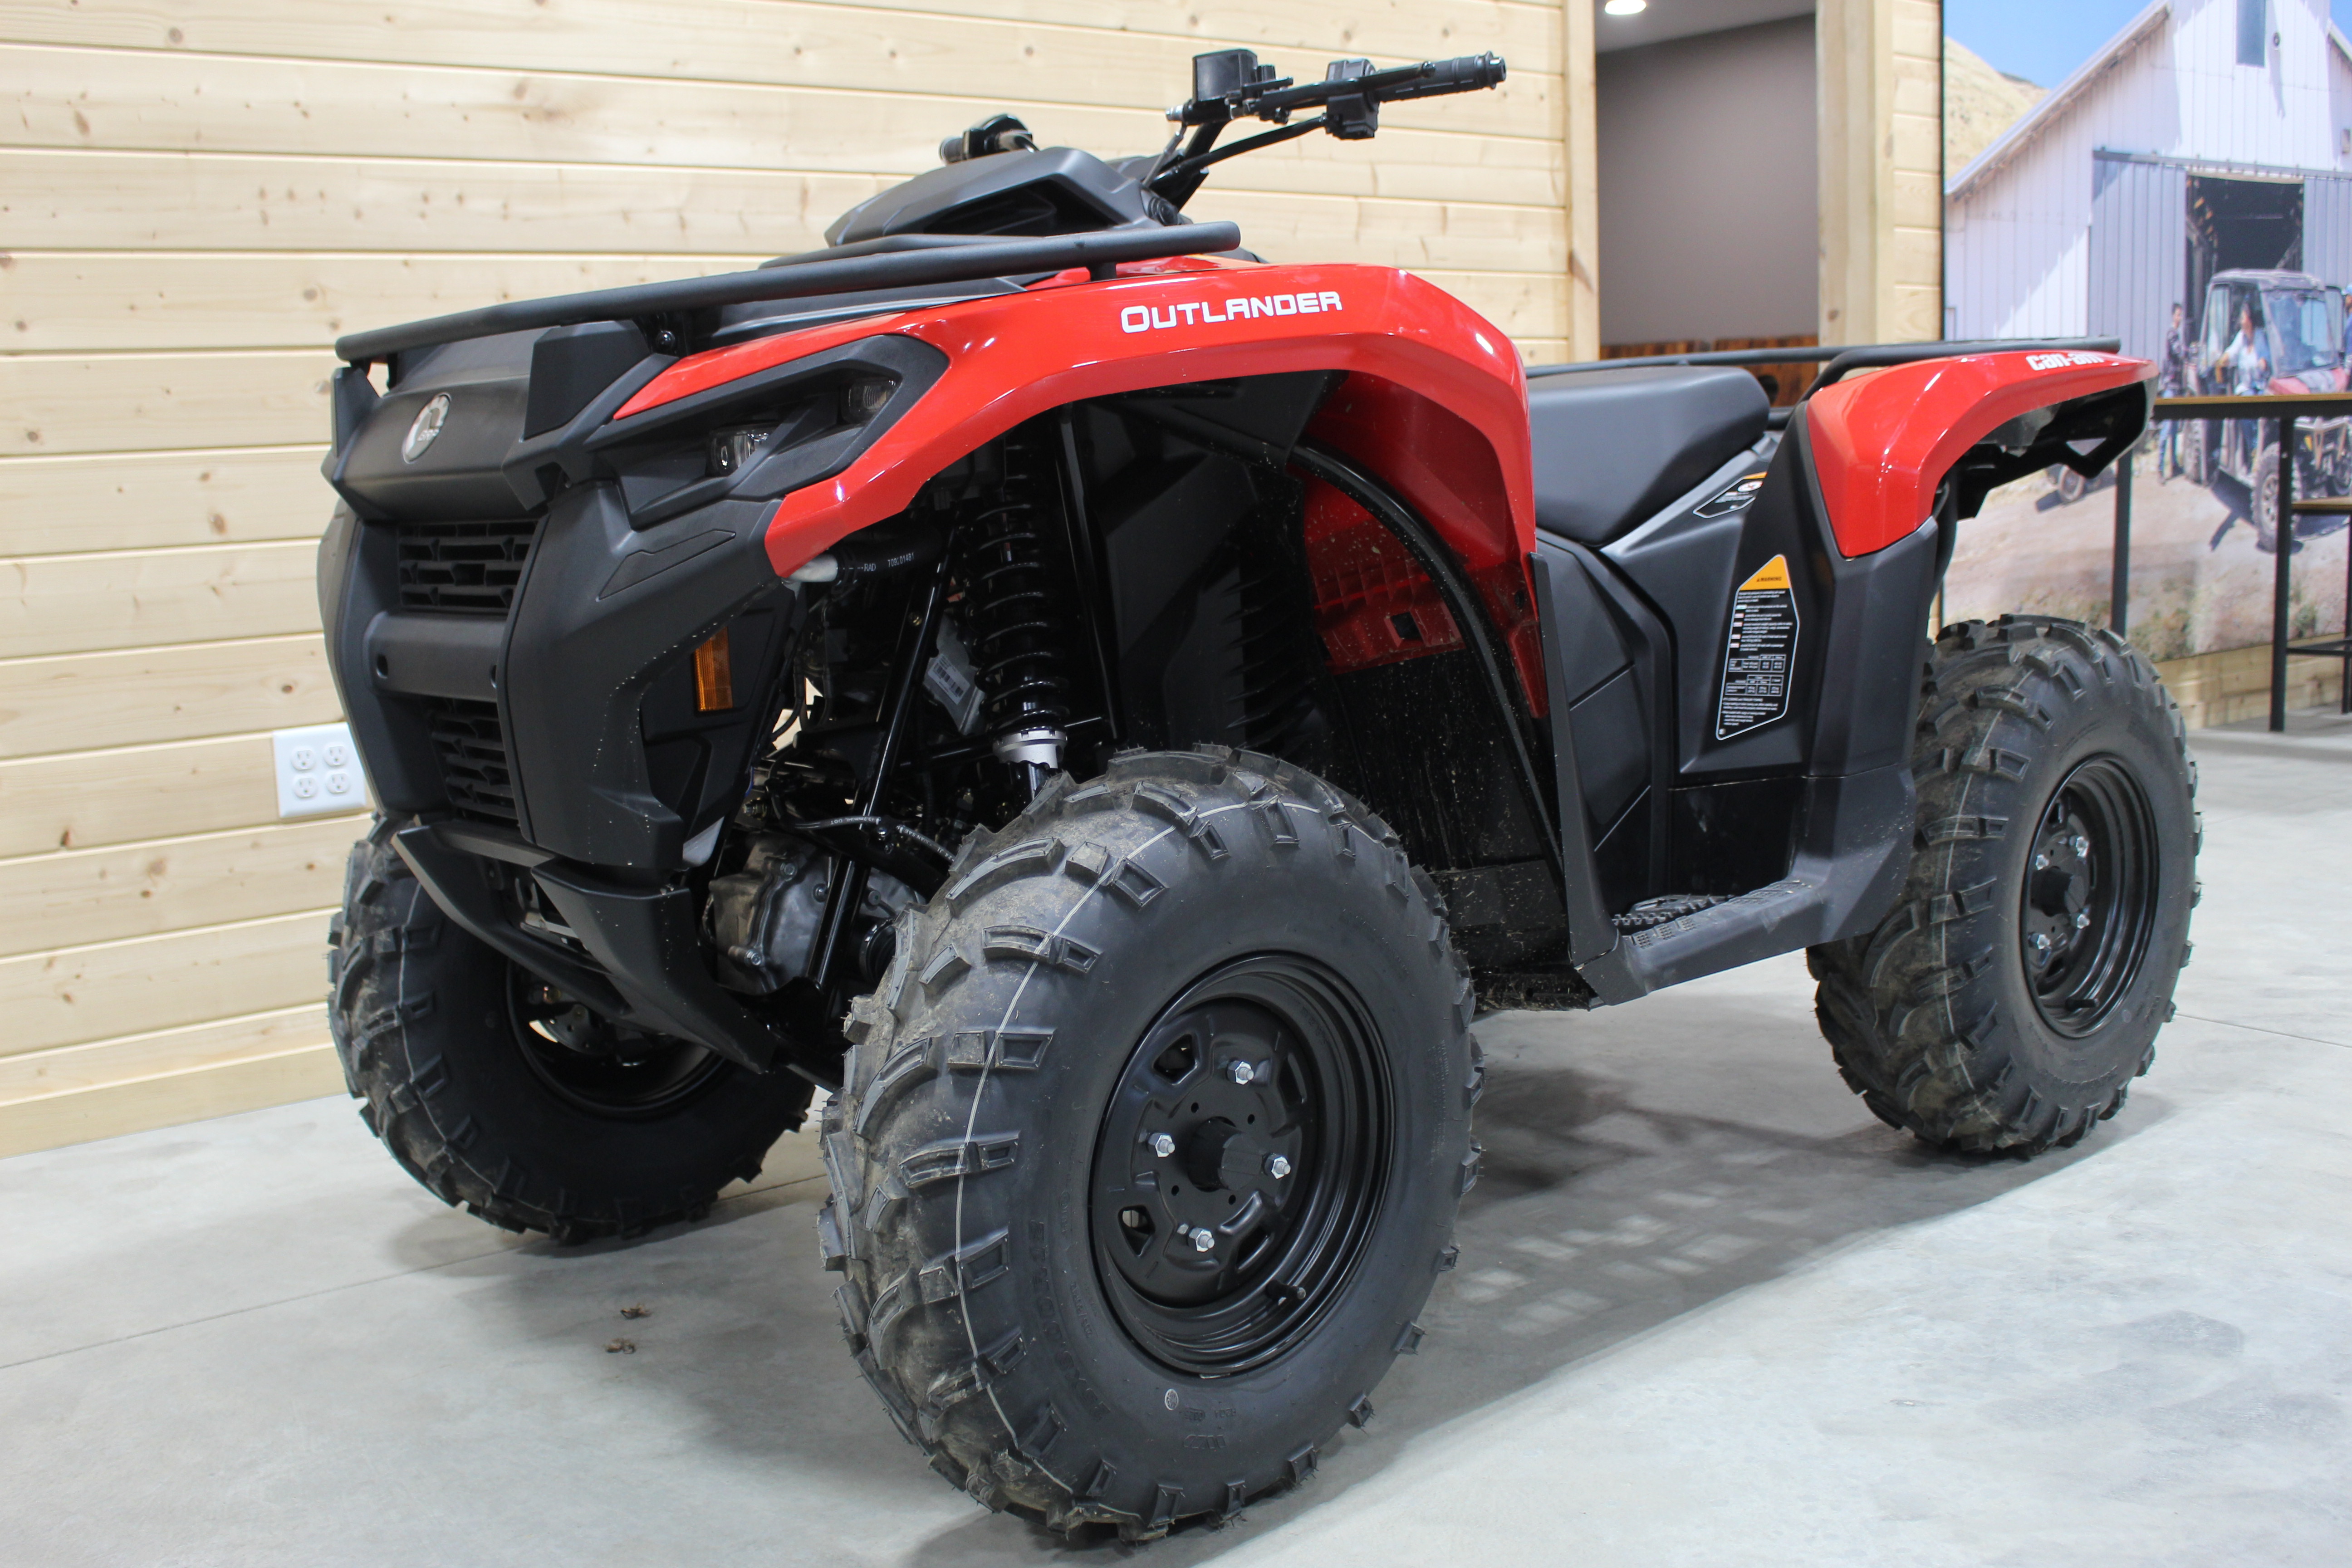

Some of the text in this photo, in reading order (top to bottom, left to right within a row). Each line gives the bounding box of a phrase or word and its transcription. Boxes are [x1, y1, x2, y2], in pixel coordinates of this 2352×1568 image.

[1120, 291, 1343, 334] OUTLANDER
[2025, 353, 2105, 371] can-am
[864, 563, 877, 573] RAD
[904, 829, 916, 838] SAE
